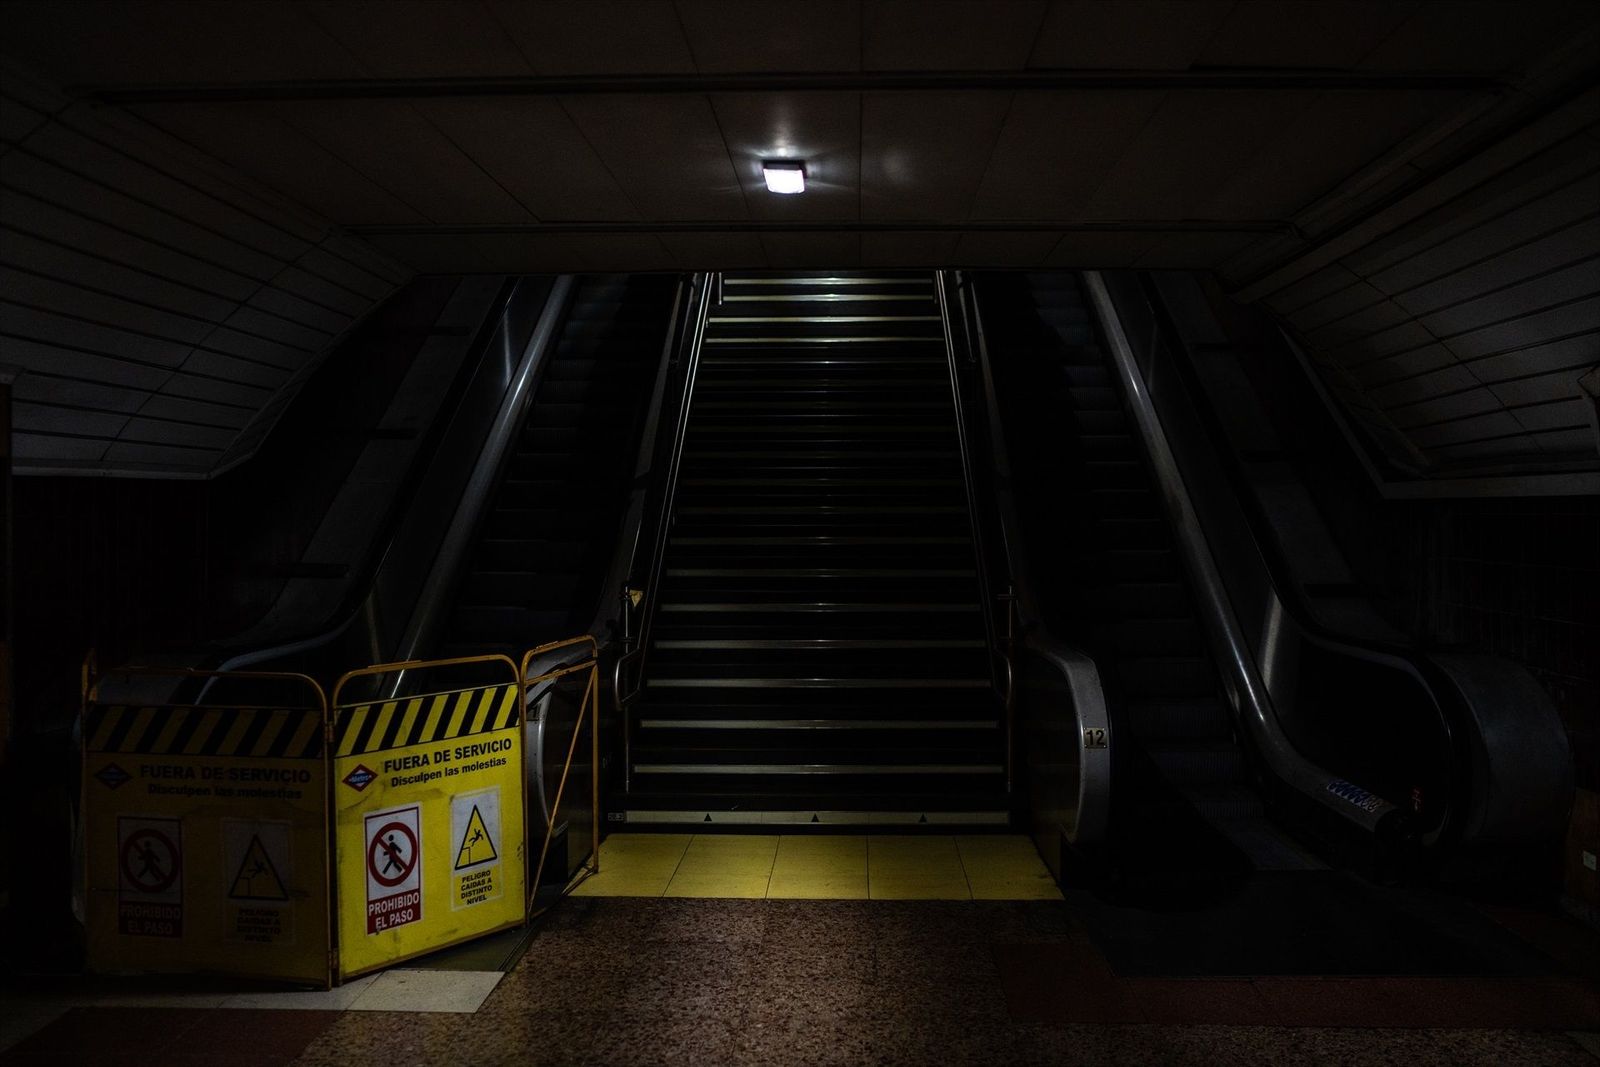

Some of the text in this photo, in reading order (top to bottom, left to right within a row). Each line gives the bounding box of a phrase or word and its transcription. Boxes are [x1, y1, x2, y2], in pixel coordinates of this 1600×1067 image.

[1086, 729, 1105, 746] 12
[384, 738, 512, 774] FUERA DE SERVICIO
[140, 765, 195, 779] FUERA
[201, 767, 224, 780] DE
[230, 768, 311, 783] SERVICIO
[391, 756, 507, 787] Disculpen las molestias
[148, 784, 303, 800] Disculpen las molestias
[460, 877, 492, 892] CAIDAS A
[461, 870, 491, 883] PELIGRO
[460, 885, 493, 900] DISTINTO
[466, 894, 488, 906] NIVEL
[120, 903, 182, 921] PROHIBIDO
[368, 892, 420, 916] PROHIBIDO
[375, 910, 414, 928] EL PASO
